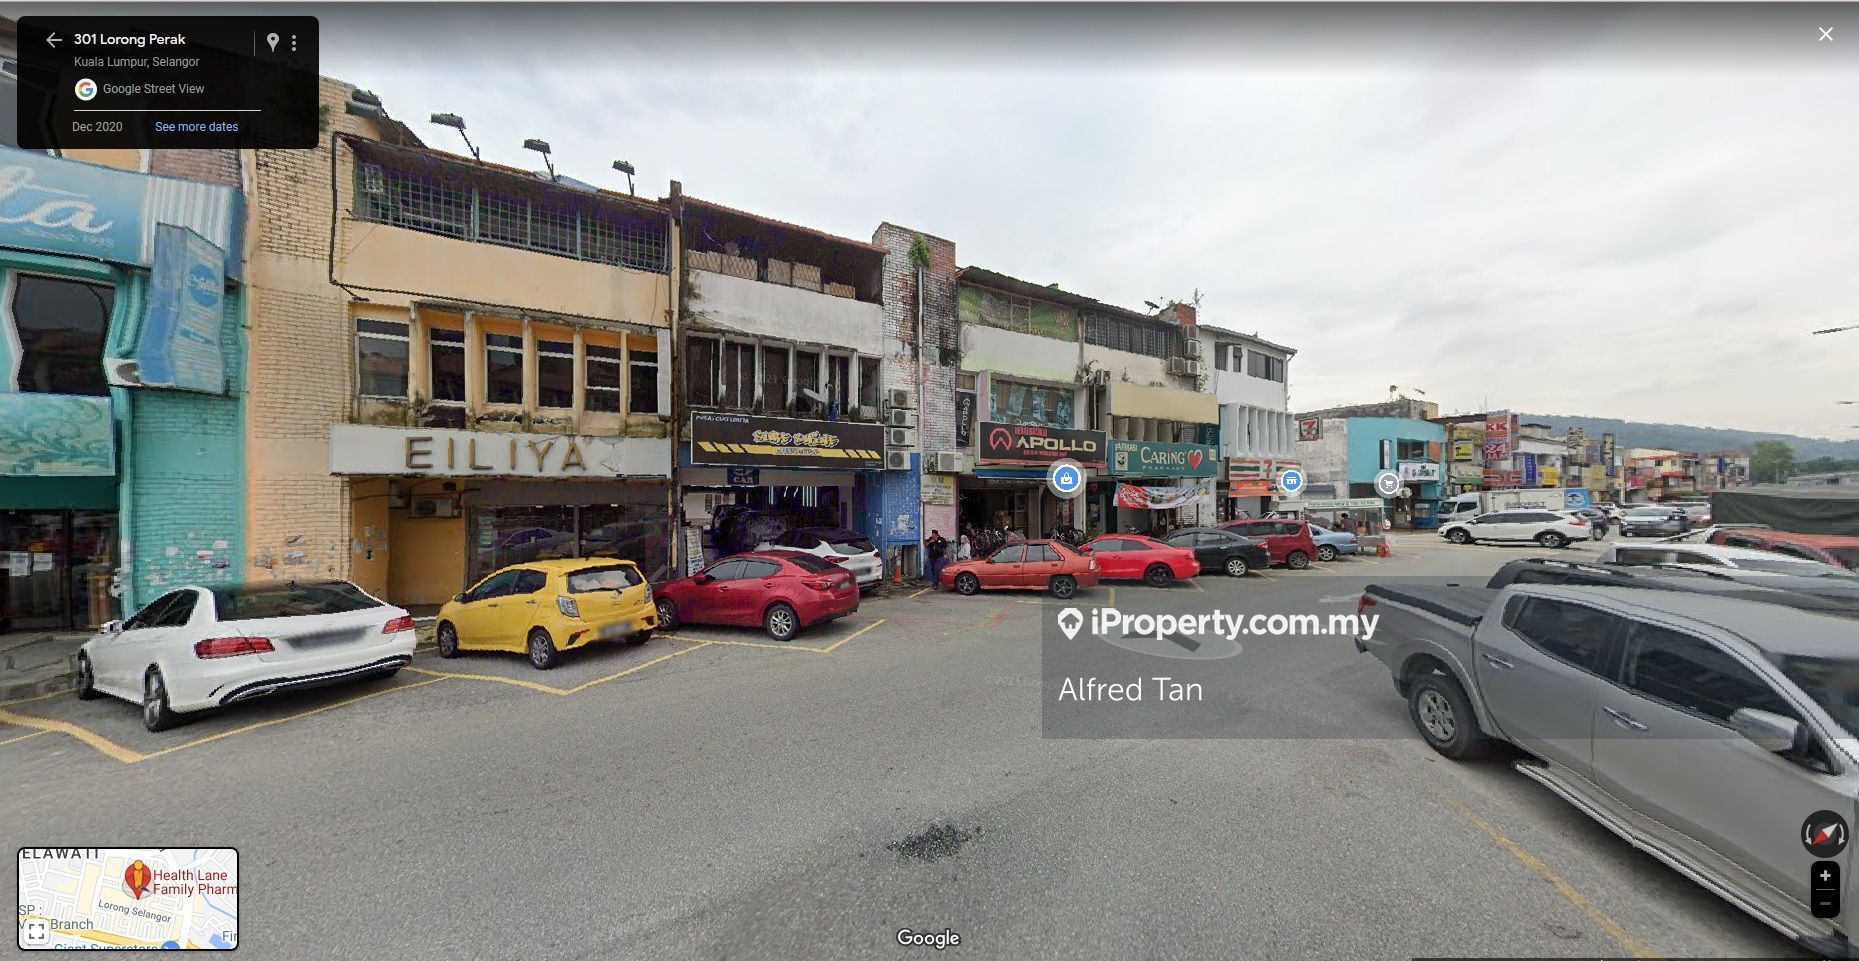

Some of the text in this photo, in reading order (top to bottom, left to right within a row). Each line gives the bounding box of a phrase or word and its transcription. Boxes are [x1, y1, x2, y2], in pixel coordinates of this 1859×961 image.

[1015, 435, 1097, 452] APOLLO
[1115, 442, 1138, 452] FARMASI
[405, 436, 586, 472] EILIYA
[1140, 446, 1186, 465] CARING
